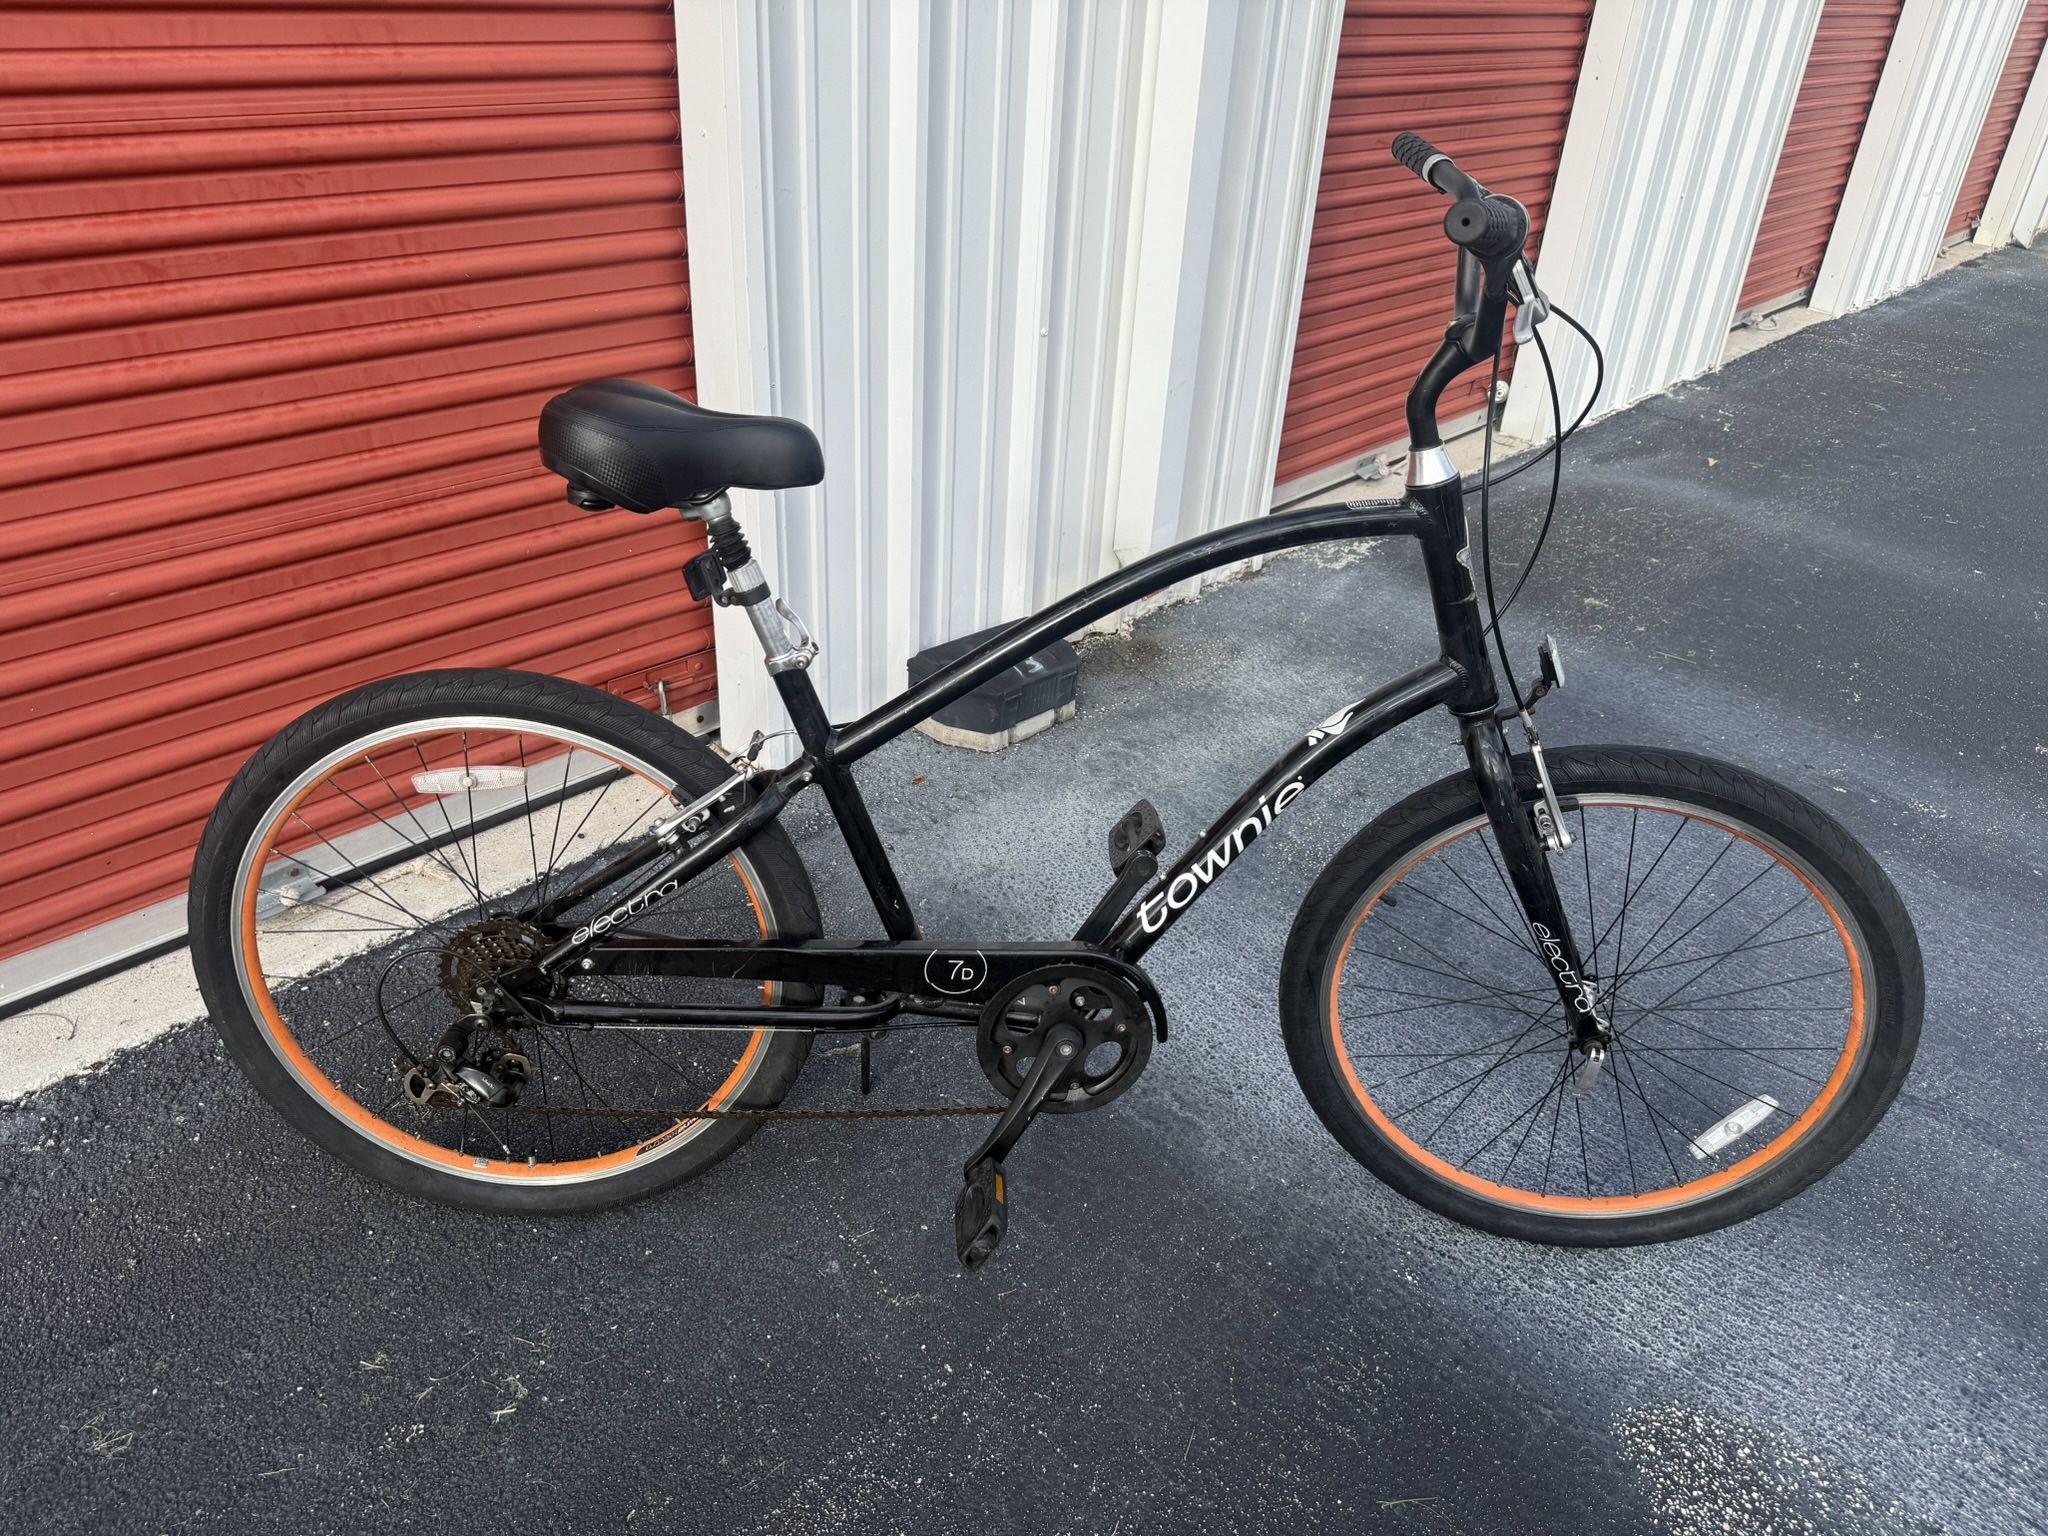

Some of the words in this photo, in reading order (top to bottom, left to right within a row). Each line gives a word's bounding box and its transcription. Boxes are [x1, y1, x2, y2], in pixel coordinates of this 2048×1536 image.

[1136, 776, 1305, 934] townie
[571, 879, 679, 945] electra
[948, 960, 974, 980] 7D
[1532, 921, 1591, 1013] electra
